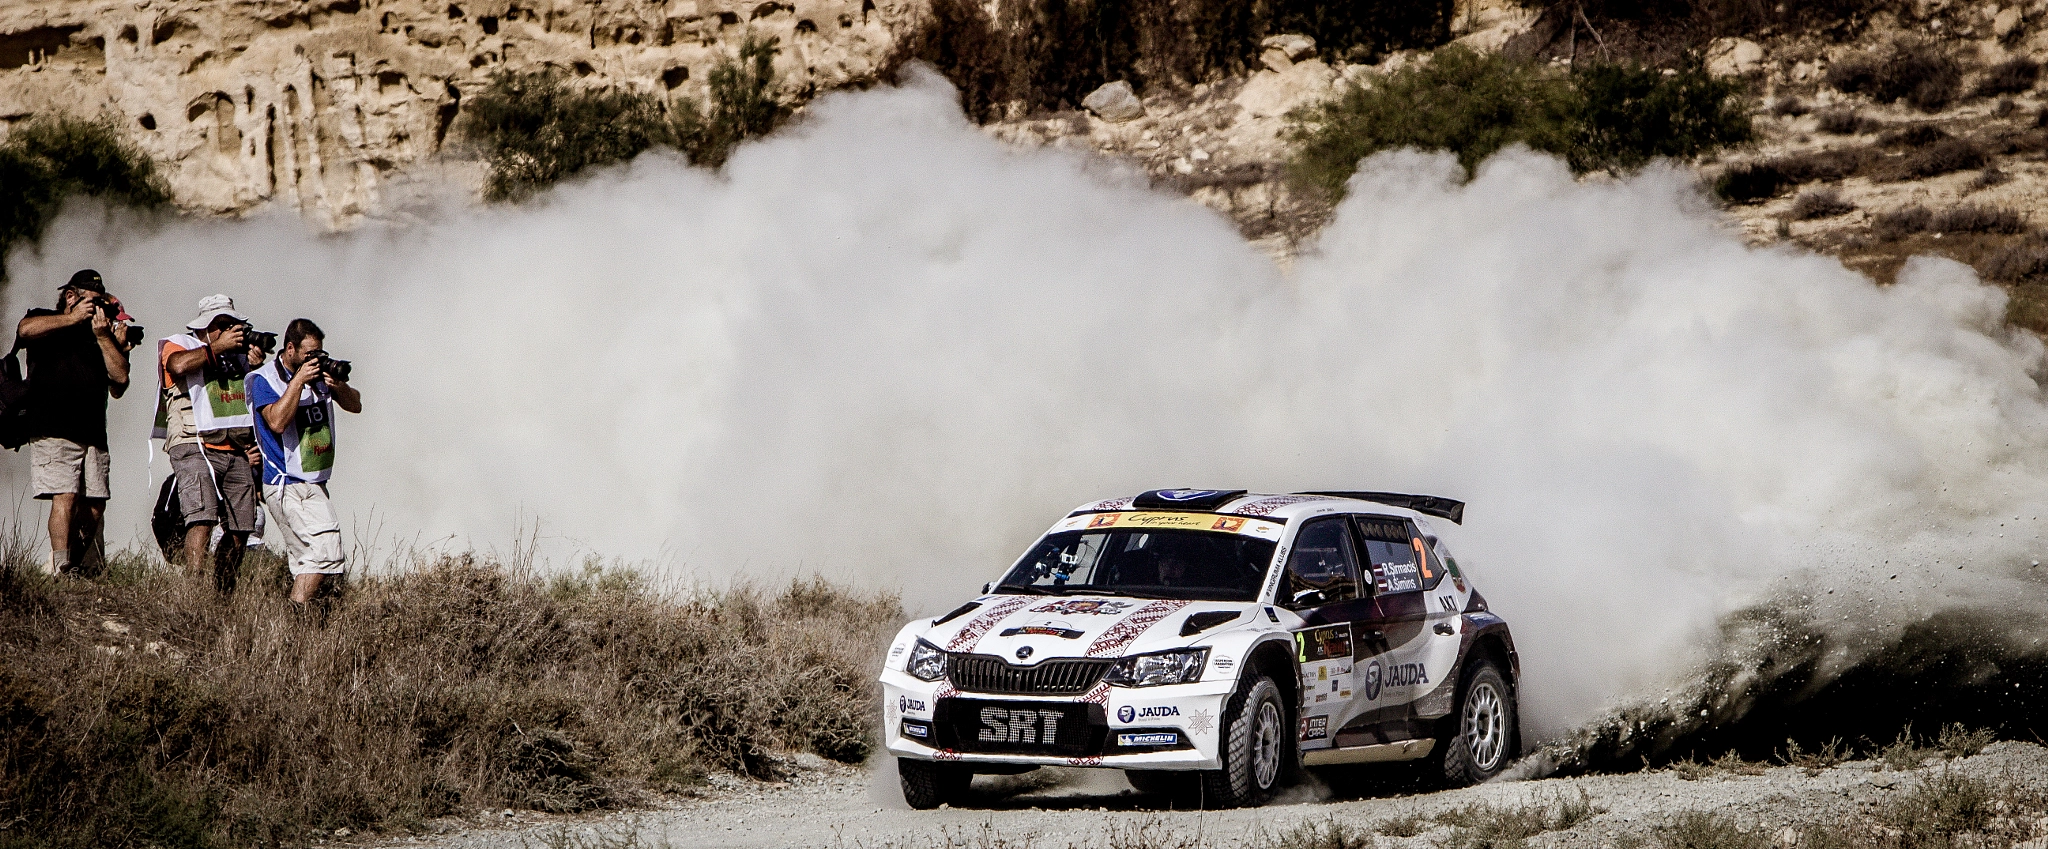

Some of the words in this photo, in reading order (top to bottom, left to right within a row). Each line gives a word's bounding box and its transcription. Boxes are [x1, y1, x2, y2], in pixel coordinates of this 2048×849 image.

[305, 406, 324, 424] 18
[1128, 513, 1188, 525] Cyprus
[1413, 537, 1433, 578] 2
[1296, 632, 1306, 663] 2
[1384, 662, 1430, 688] JAUDA
[907, 698, 926, 712] JAUDA
[1138, 705, 1181, 717] JAUDA
[978, 706, 1064, 745] SRT
[1309, 717, 1327, 728] INTER
[1133, 734, 1174, 742] MICHELIN
[1307, 727, 1325, 738] CARS
